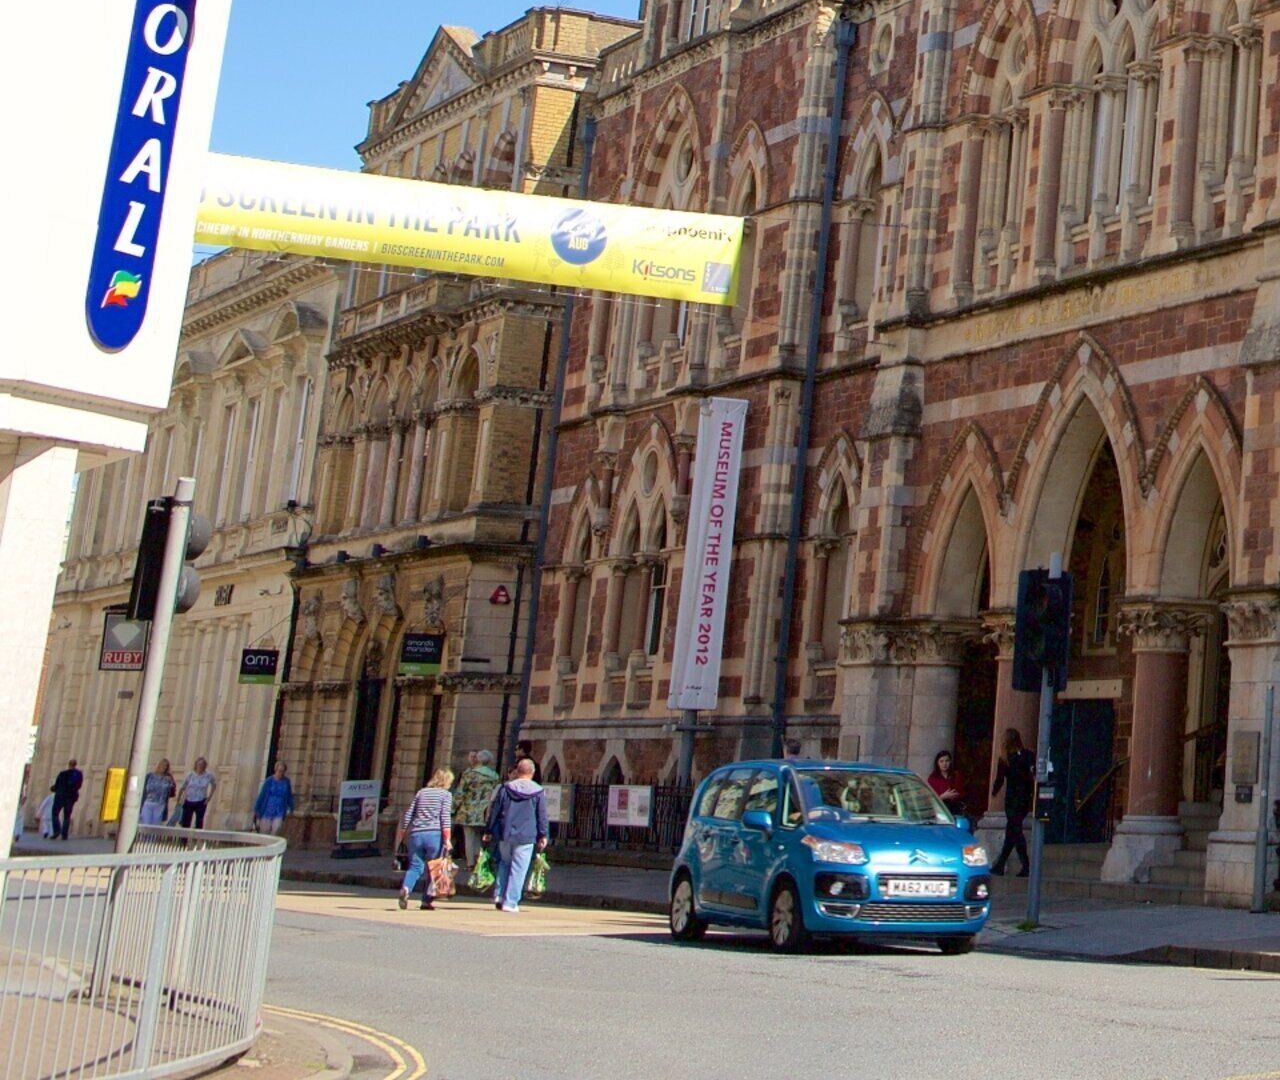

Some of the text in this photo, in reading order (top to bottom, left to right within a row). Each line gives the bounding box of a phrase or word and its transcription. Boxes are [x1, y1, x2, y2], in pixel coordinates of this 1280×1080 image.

[446, 205, 522, 244] PARK
[324, 236, 370, 252] GARDENS
[380, 243, 505, 269] BIGSCREENINTHEPARK.COM
[631, 258, 697, 282] Kitsons
[694, 420, 734, 666] MUSEUM OF THE YEAR 2012
[103, 651, 142, 665] RUBY
